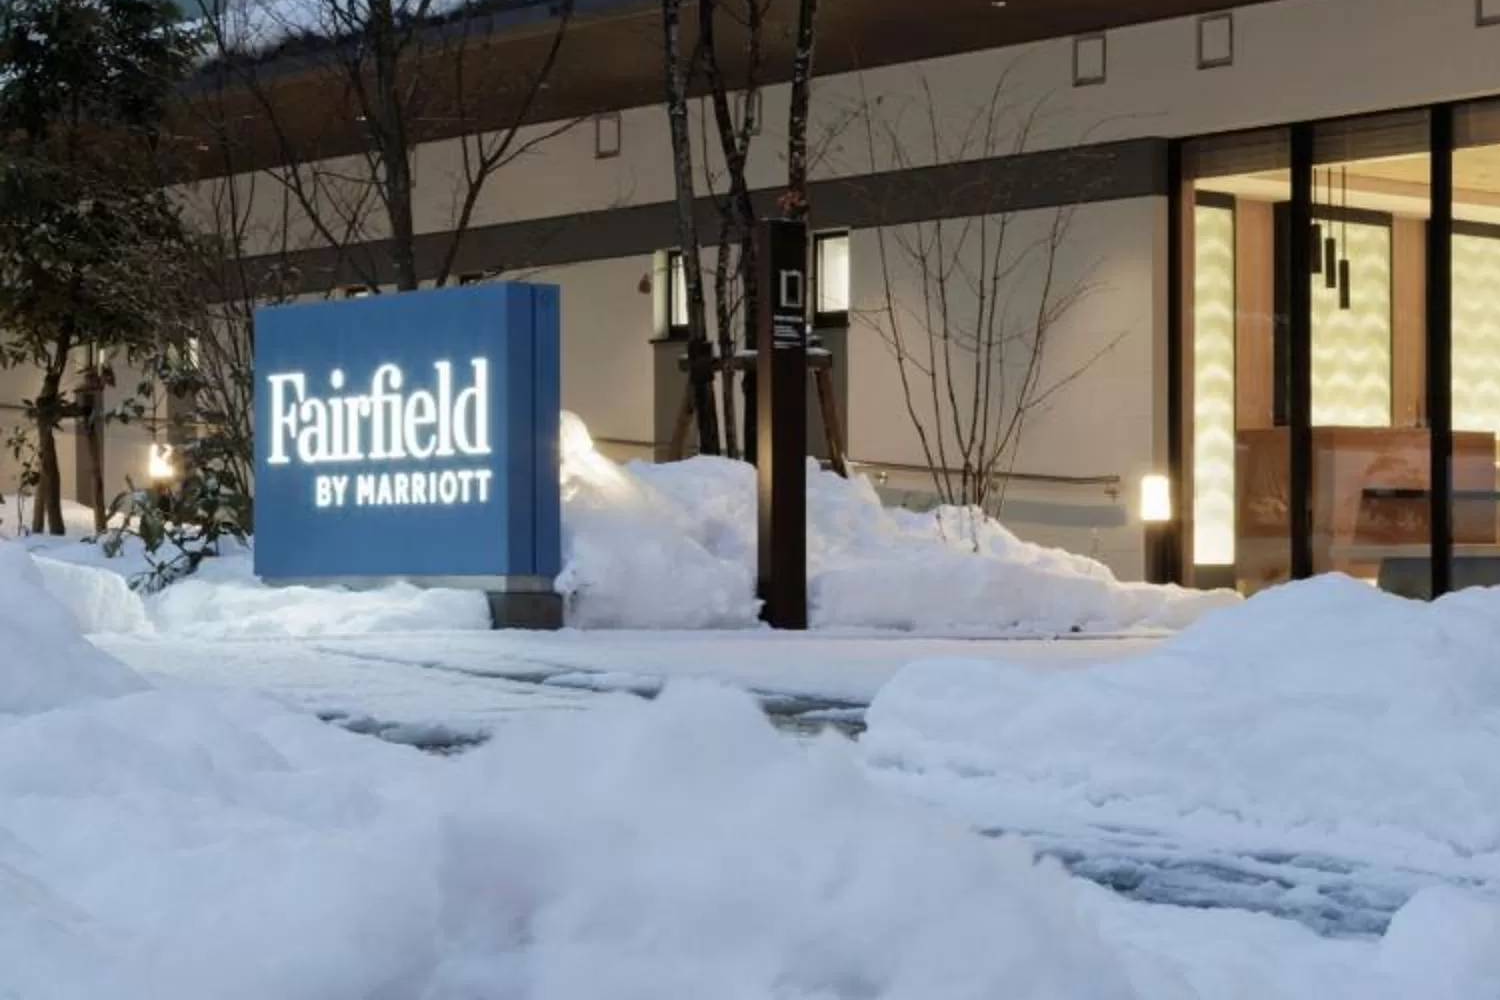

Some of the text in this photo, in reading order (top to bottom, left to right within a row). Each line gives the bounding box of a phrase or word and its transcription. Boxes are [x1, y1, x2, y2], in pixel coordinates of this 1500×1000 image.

[267, 356, 492, 465] Fairfield
[315, 468, 492, 508] BY MARRIOTT
